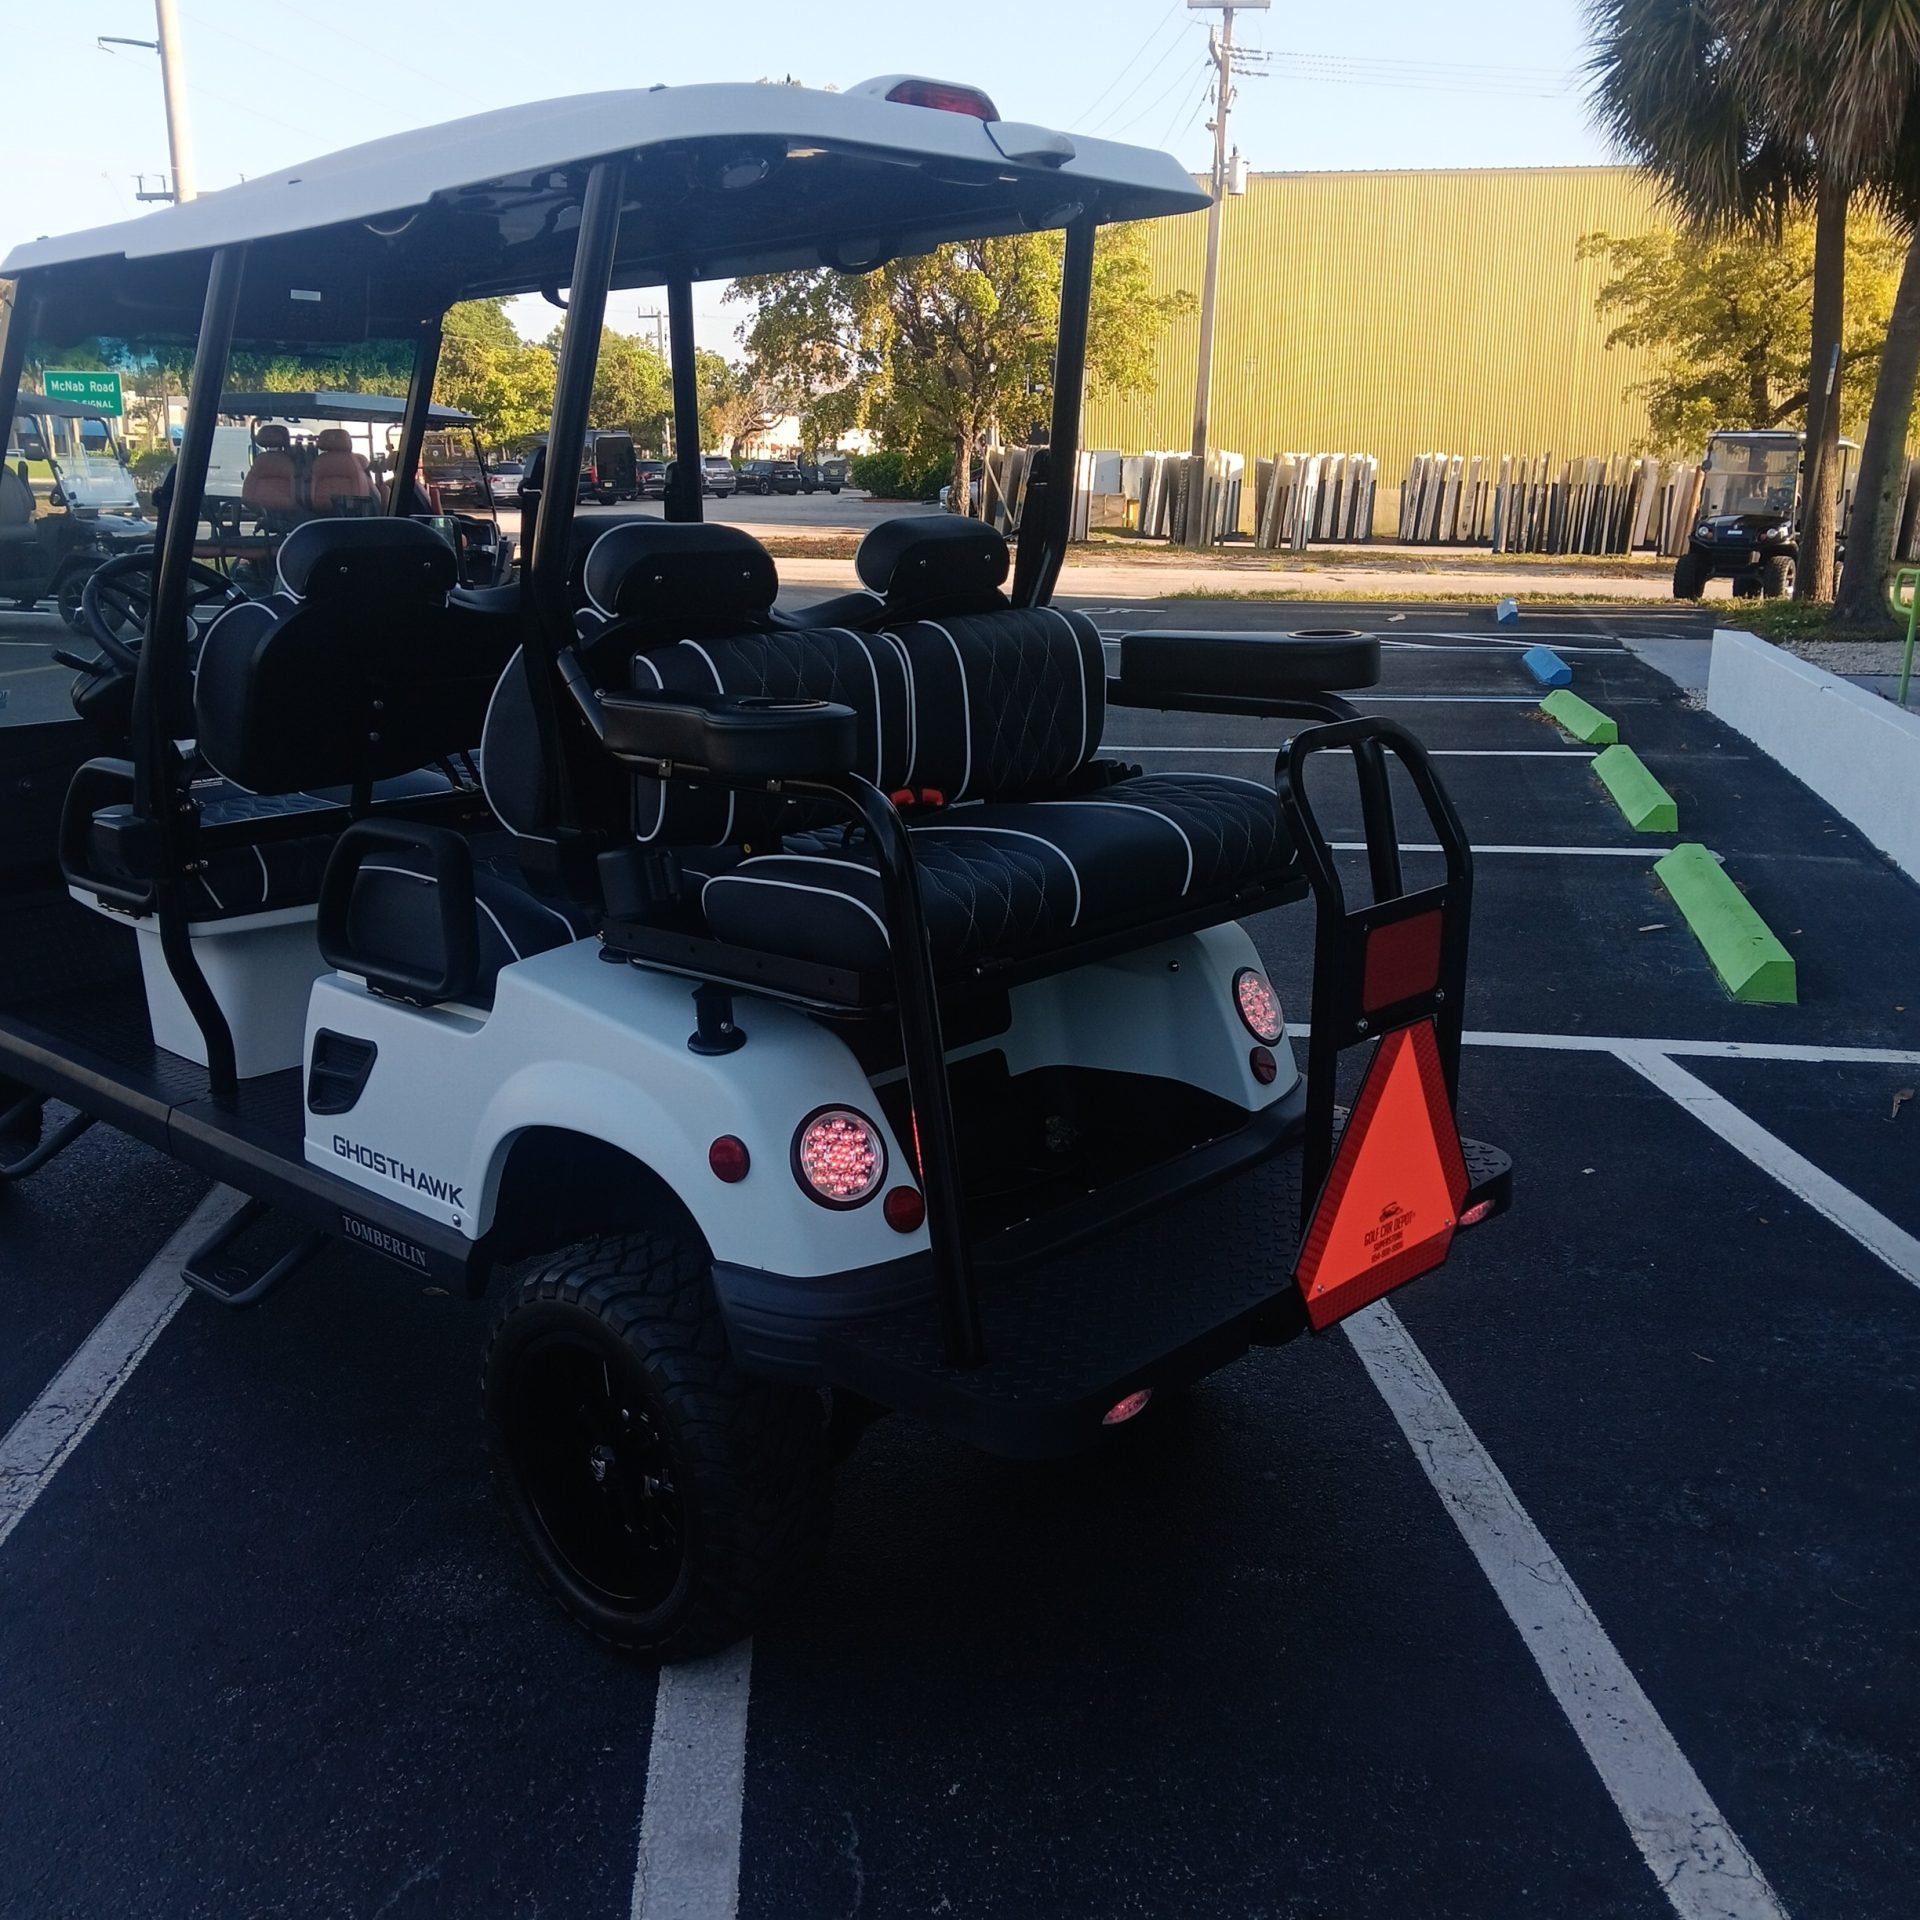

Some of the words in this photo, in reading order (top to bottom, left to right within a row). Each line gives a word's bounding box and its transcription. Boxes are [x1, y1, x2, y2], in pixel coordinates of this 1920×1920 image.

[51, 380, 85, 392] McNab
[89, 381, 115, 393] Road
[333, 1134, 465, 1209] GHOSTHAWK
[342, 1215, 426, 1268] TOMBERLIN
[1364, 1227, 1380, 1247] GOLF
[1380, 1220, 1393, 1238] CAR
